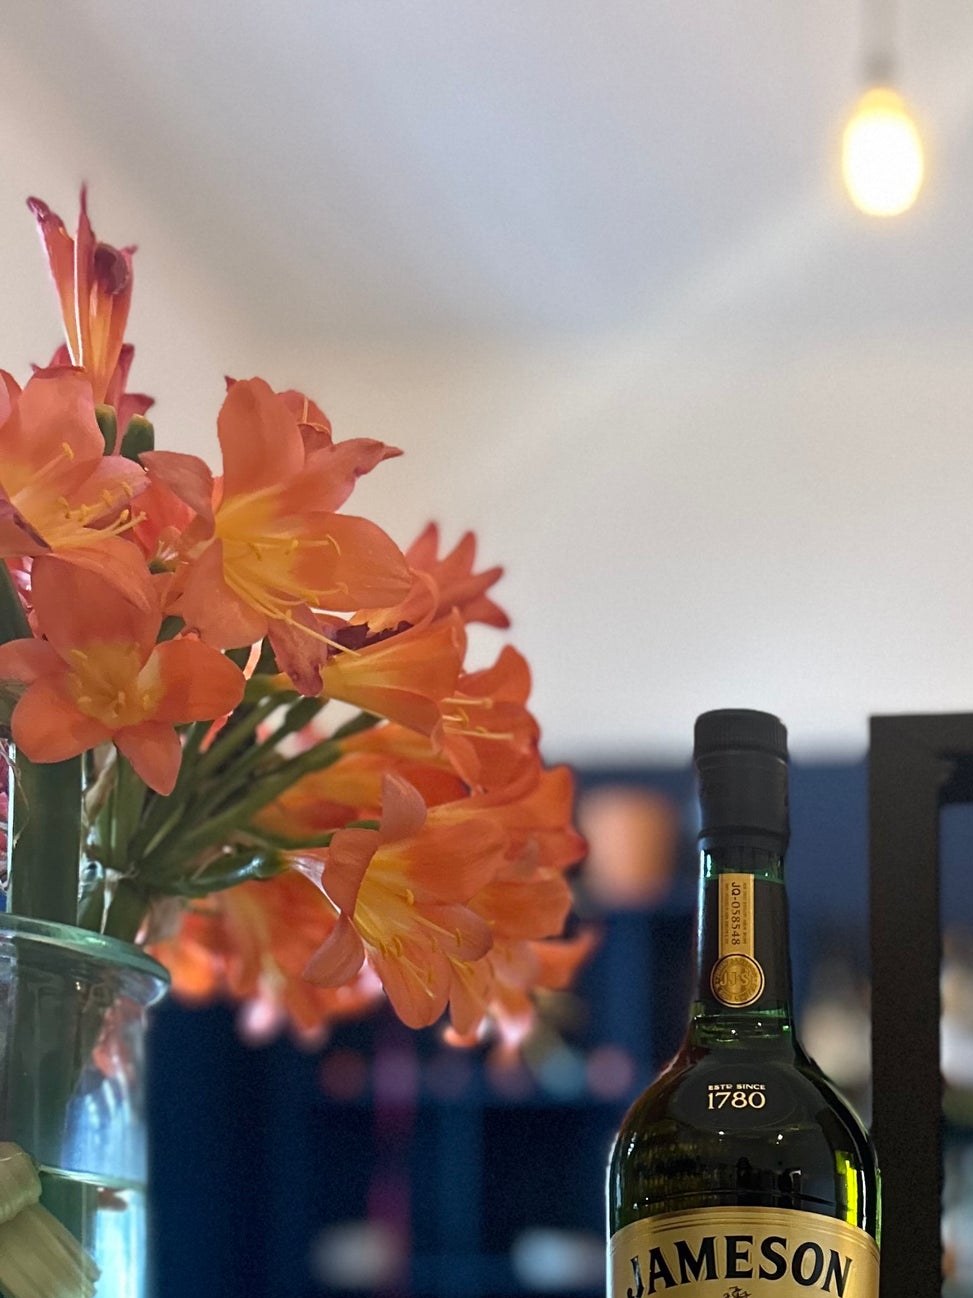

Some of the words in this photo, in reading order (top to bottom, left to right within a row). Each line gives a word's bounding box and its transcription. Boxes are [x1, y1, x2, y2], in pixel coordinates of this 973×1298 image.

[731, 882, 741, 946] JQ-058548
[736, 1083, 766, 1091] SINCE
[708, 1091, 766, 1110] 1780
